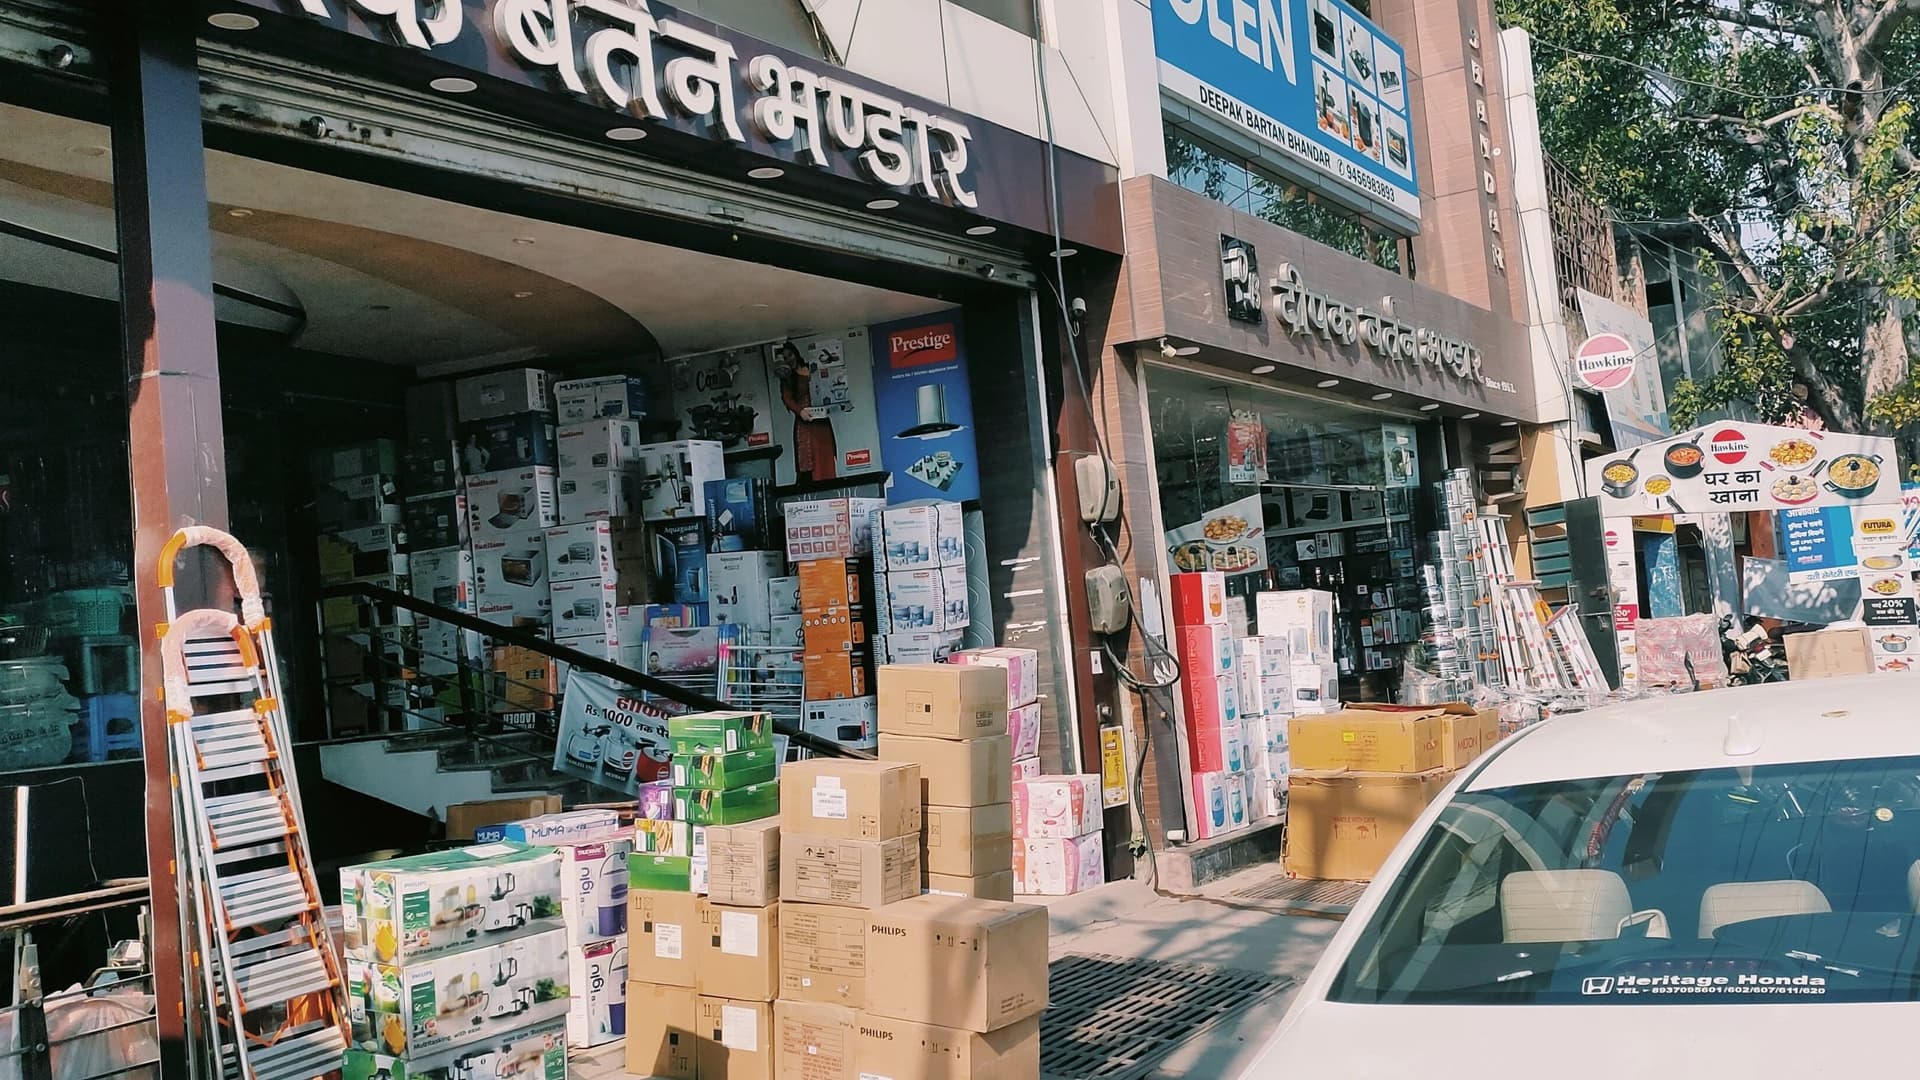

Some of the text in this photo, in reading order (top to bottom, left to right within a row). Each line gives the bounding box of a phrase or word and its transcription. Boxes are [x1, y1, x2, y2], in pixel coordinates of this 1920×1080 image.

[1168, 0, 1296, 86] LEN
[748, 54, 978, 207] भण्डार
[1199, 84, 1396, 203] DEEPAK BARTAN BHANDAR 9456983893
[1269, 262, 1485, 384] दीपक बर्तन भण्डार
[891, 330, 951, 354] Prestige
[1578, 354, 1633, 371] Hawkins
[1711, 441, 1749, 453] Hawkins
[1704, 470, 1760, 487] घर का
[1709, 488, 1759, 504] खाना
[664, 522, 699, 534] Aquaguard
[1864, 521, 1892, 529] FUTURA
[586, 704, 600, 717] Rs.
[602, 709, 633, 728] 1000
[636, 722, 654, 733] तक
[477, 831, 501, 841] MUMA
[532, 825, 565, 840] MUMA
[579, 867, 594, 895] iglu
[871, 924, 907, 937] PHILIPS
[403, 943, 443, 958] Multitasking
[445, 940, 460, 950] with
[589, 964, 605, 995] iglu
[1617, 974, 1826, 988] Heritage Honda
[413, 1034, 452, 1050] Multitasking
[453, 1030, 467, 1040] with
[860, 1026, 894, 1041] PHILIPS
